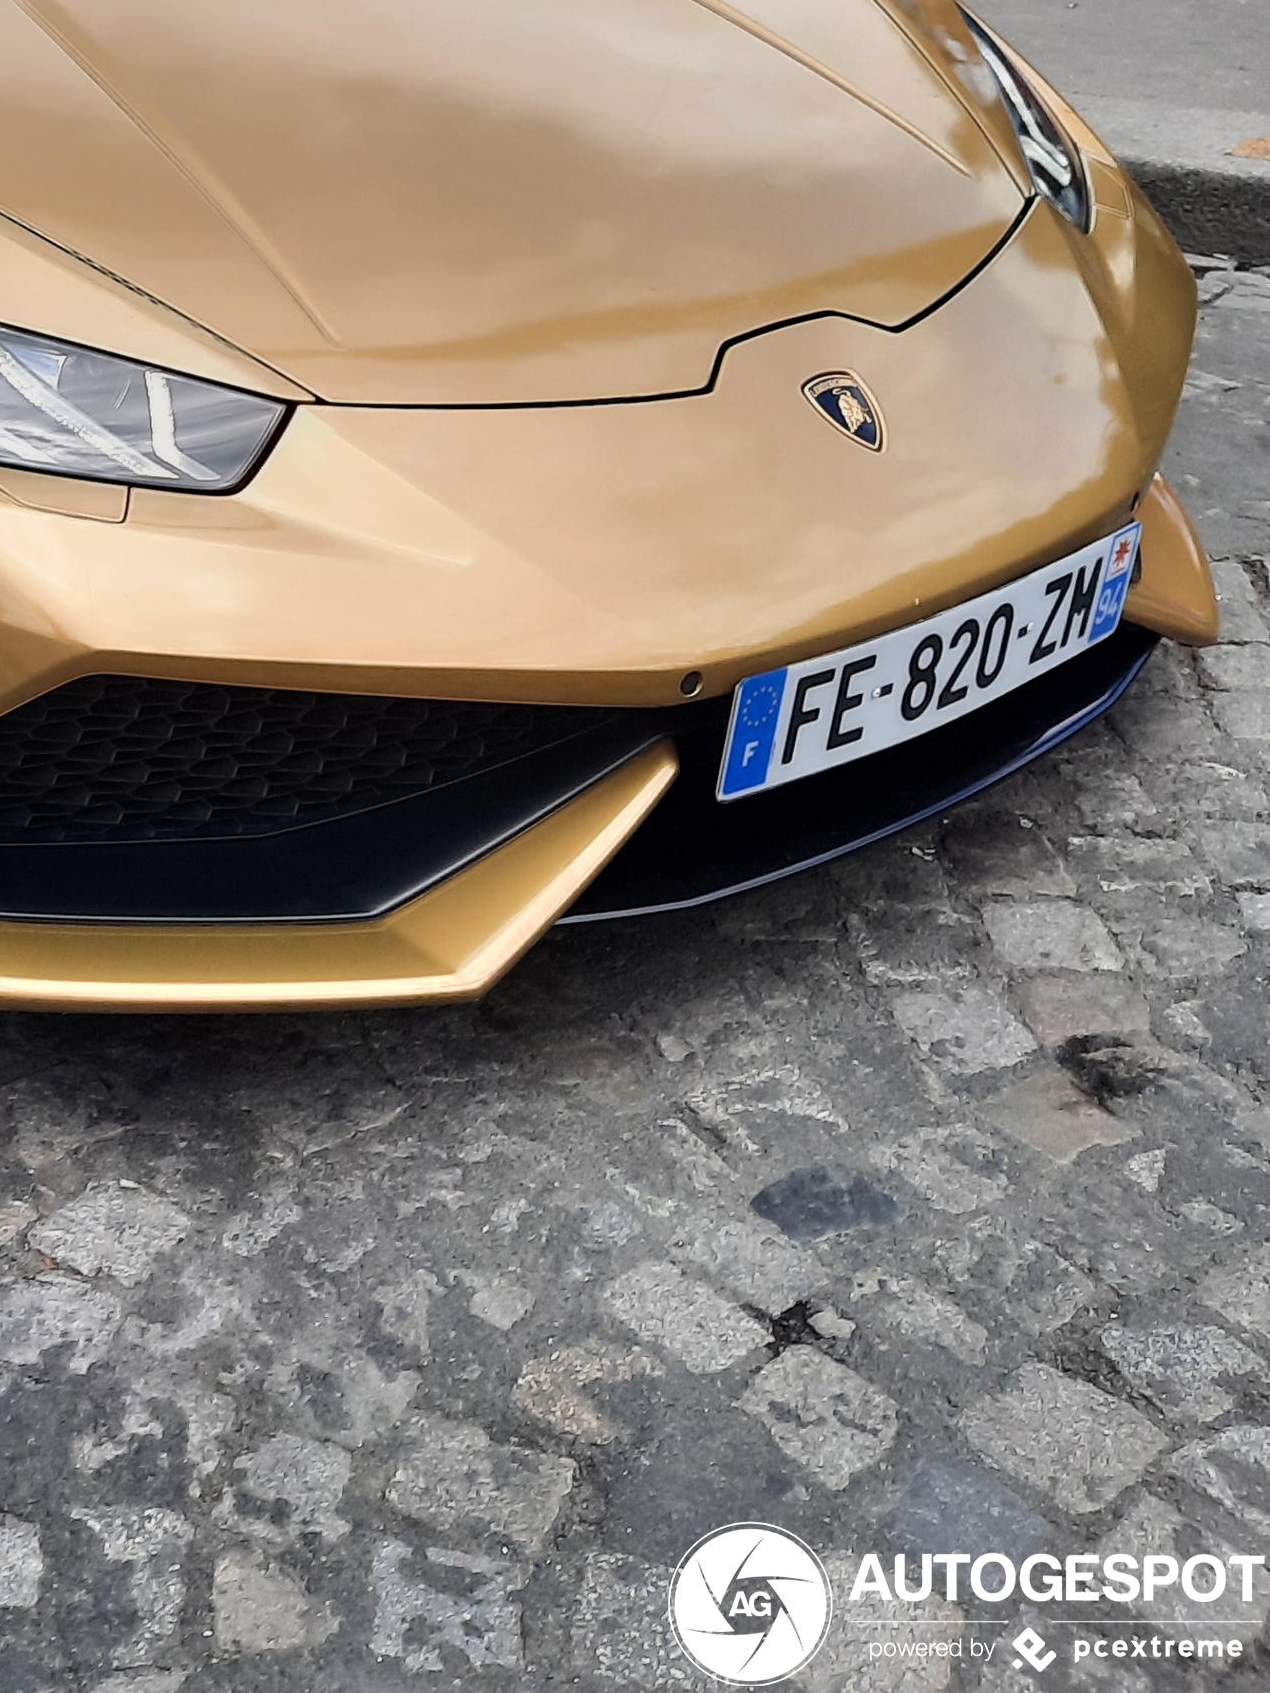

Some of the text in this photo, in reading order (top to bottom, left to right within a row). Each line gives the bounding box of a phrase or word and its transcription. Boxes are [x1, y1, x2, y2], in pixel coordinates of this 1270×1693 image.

[1094, 581, 1123, 625] 94
[781, 556, 1104, 765] FE-820-ZM
[741, 740, 760, 768] F
